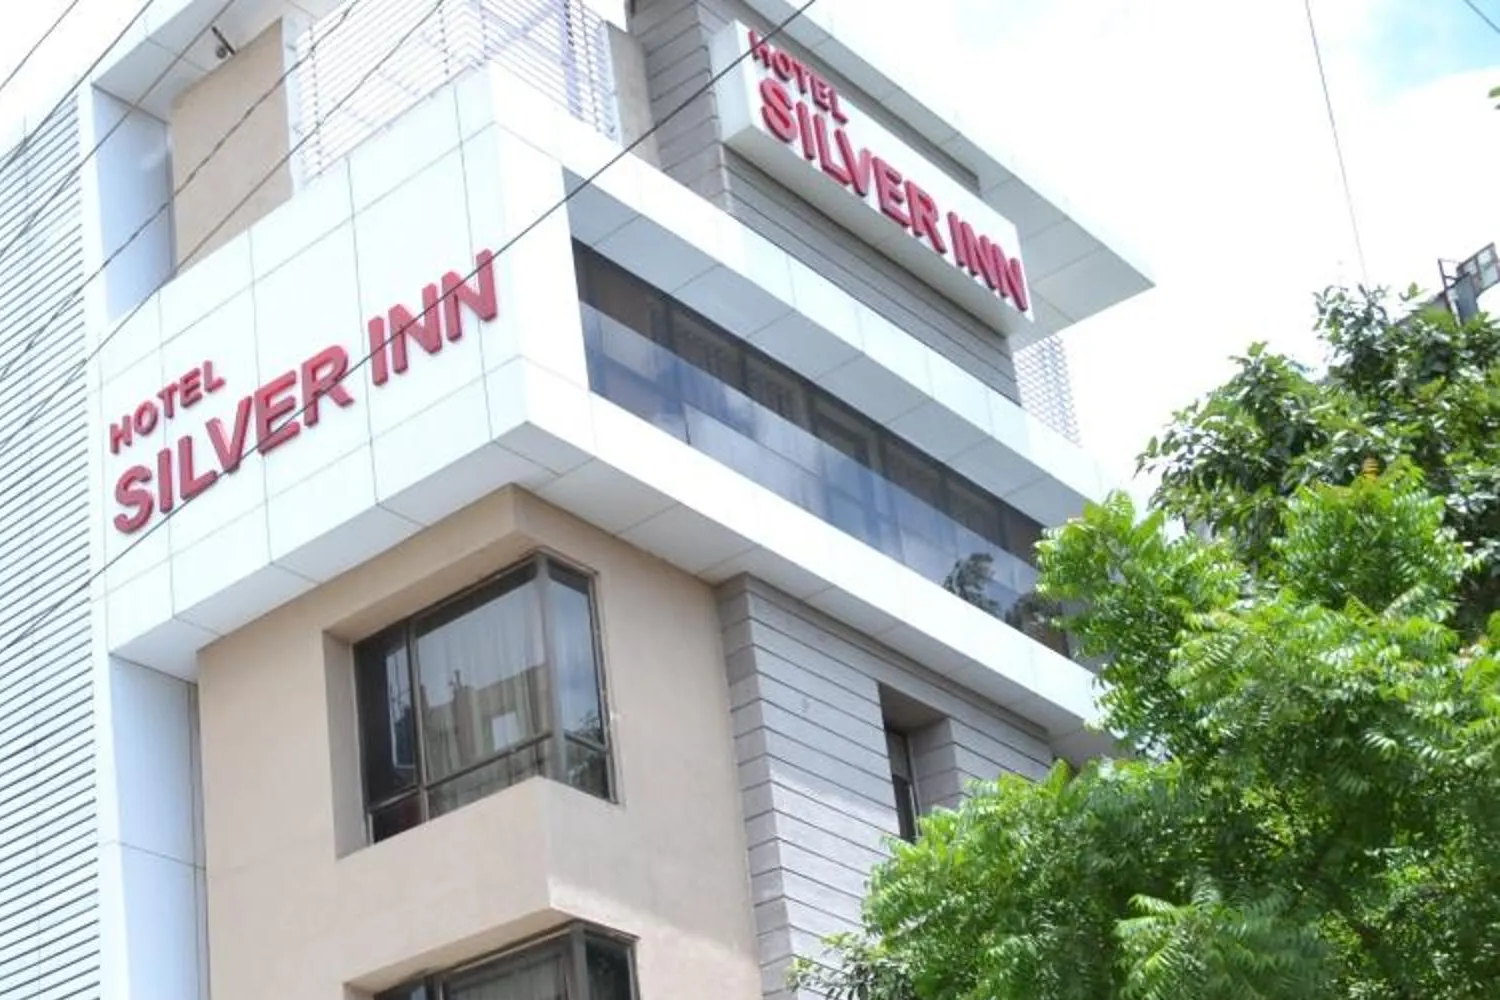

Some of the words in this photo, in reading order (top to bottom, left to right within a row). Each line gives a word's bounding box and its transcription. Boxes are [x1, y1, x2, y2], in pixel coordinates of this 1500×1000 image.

[748, 29, 849, 126] HOTEL
[760, 78, 947, 254] SILVER
[947, 211, 1028, 313] INN
[109, 360, 226, 455] HOTEL
[113, 345, 355, 534] SILVER
[367, 248, 498, 387] INN
